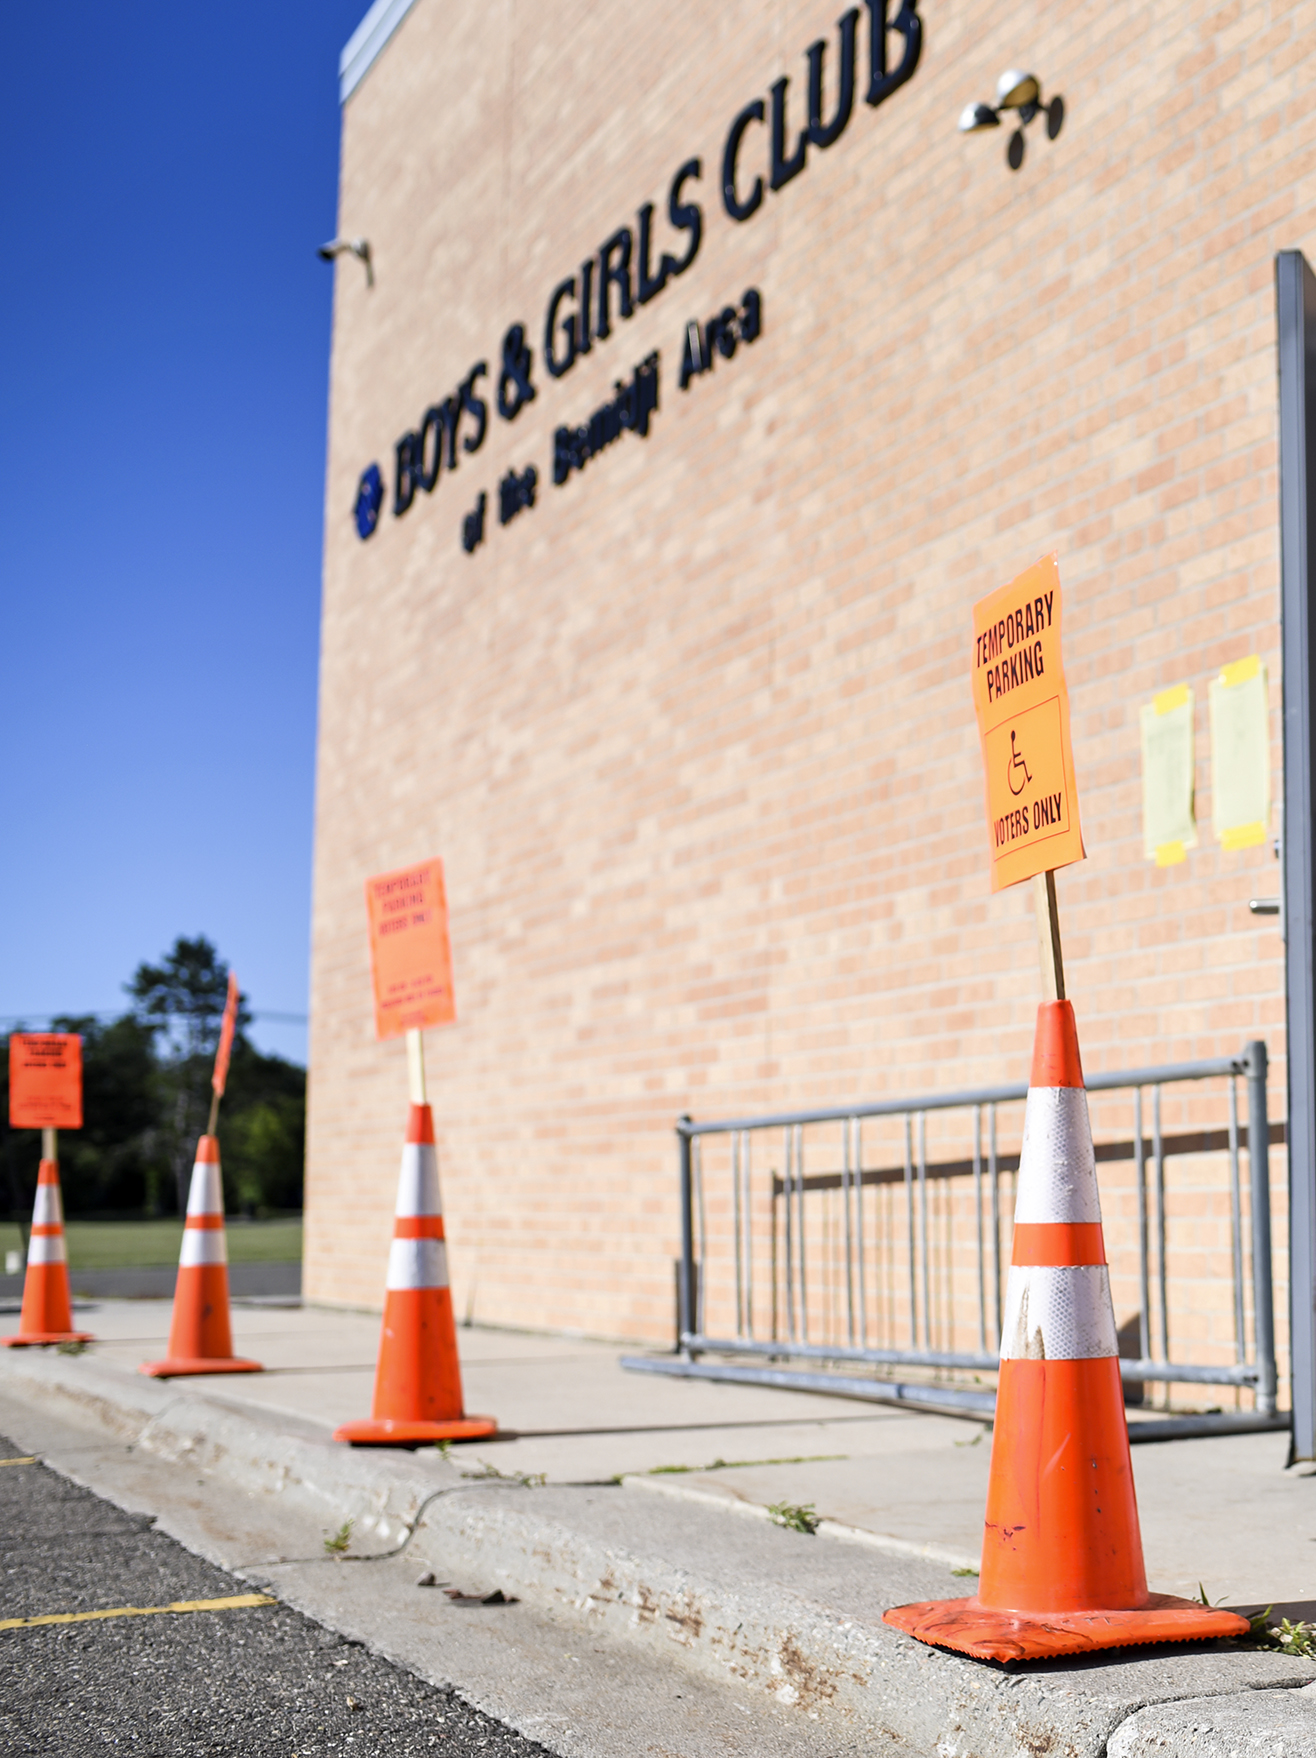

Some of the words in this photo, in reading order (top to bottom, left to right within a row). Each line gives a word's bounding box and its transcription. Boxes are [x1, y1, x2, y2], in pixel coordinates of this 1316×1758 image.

[394, 361, 487, 517] BOYS
[498, 322, 537, 421] &
[544, 157, 702, 378] GIRLS
[720, 0, 923, 222] CLUB
[678, 288, 763, 390] Area
[977, 590, 1054, 668] TEMPORARY
[986, 640, 1045, 703] PARKING
[993, 806, 1029, 847] VOTERS
[1033, 792, 1062, 832] ONLY
